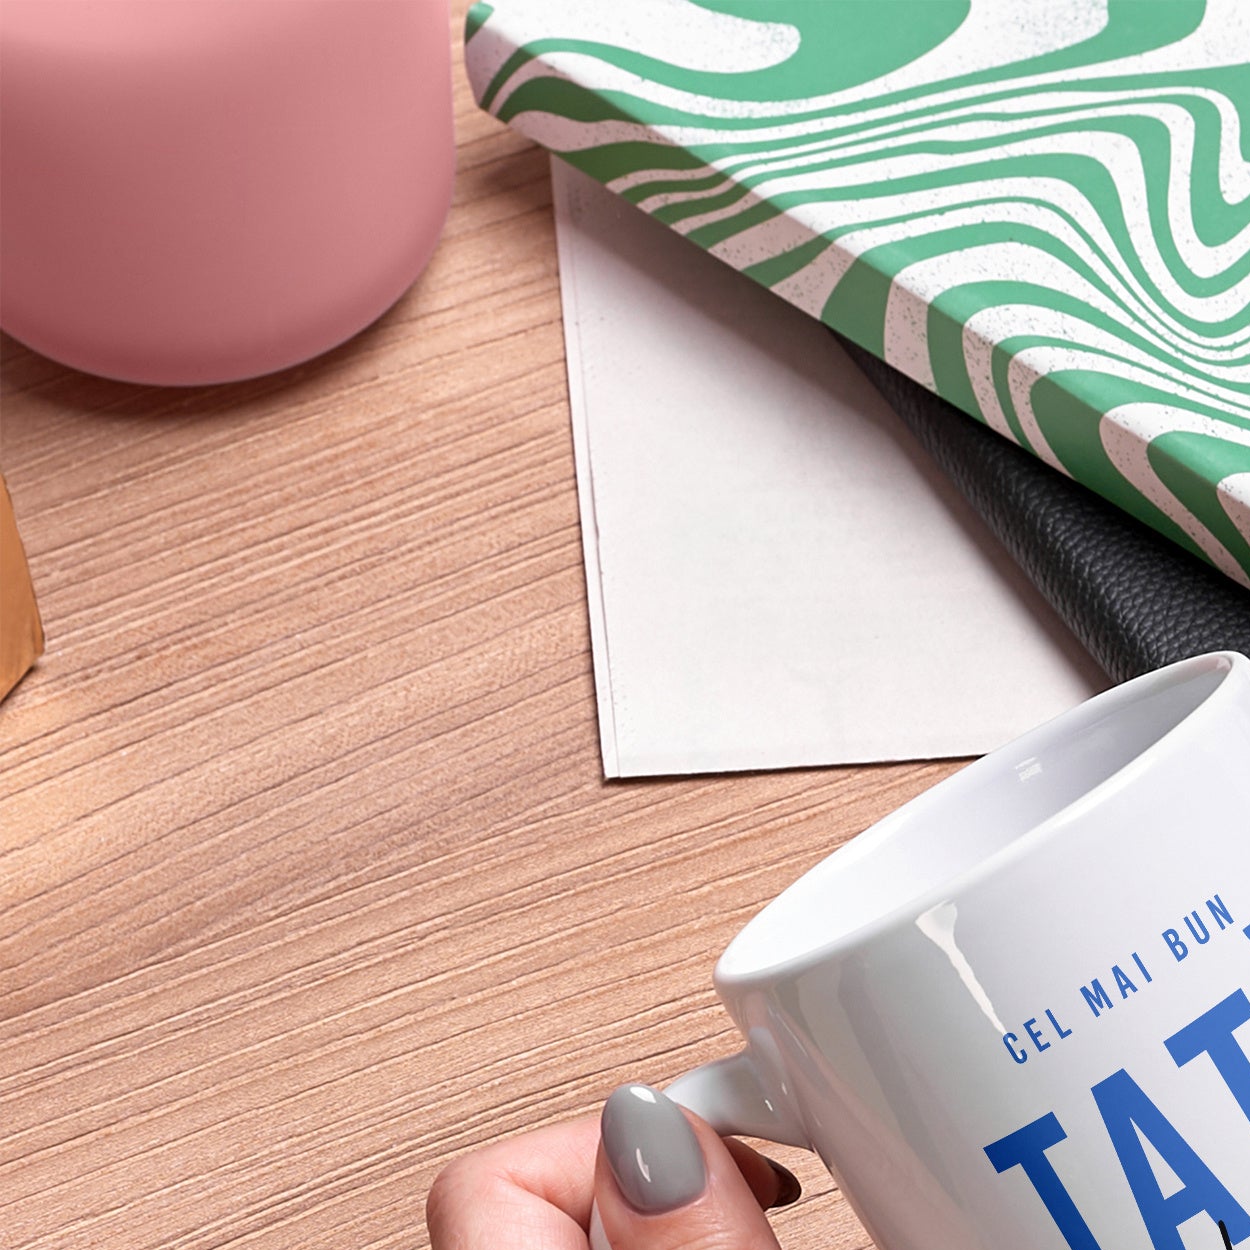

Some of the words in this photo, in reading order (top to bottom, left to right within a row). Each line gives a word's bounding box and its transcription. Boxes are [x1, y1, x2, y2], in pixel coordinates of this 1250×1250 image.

[1002, 1008, 1073, 1065] CEL
[1079, 952, 1153, 1018] MAI
[1161, 894, 1235, 963] BUN
